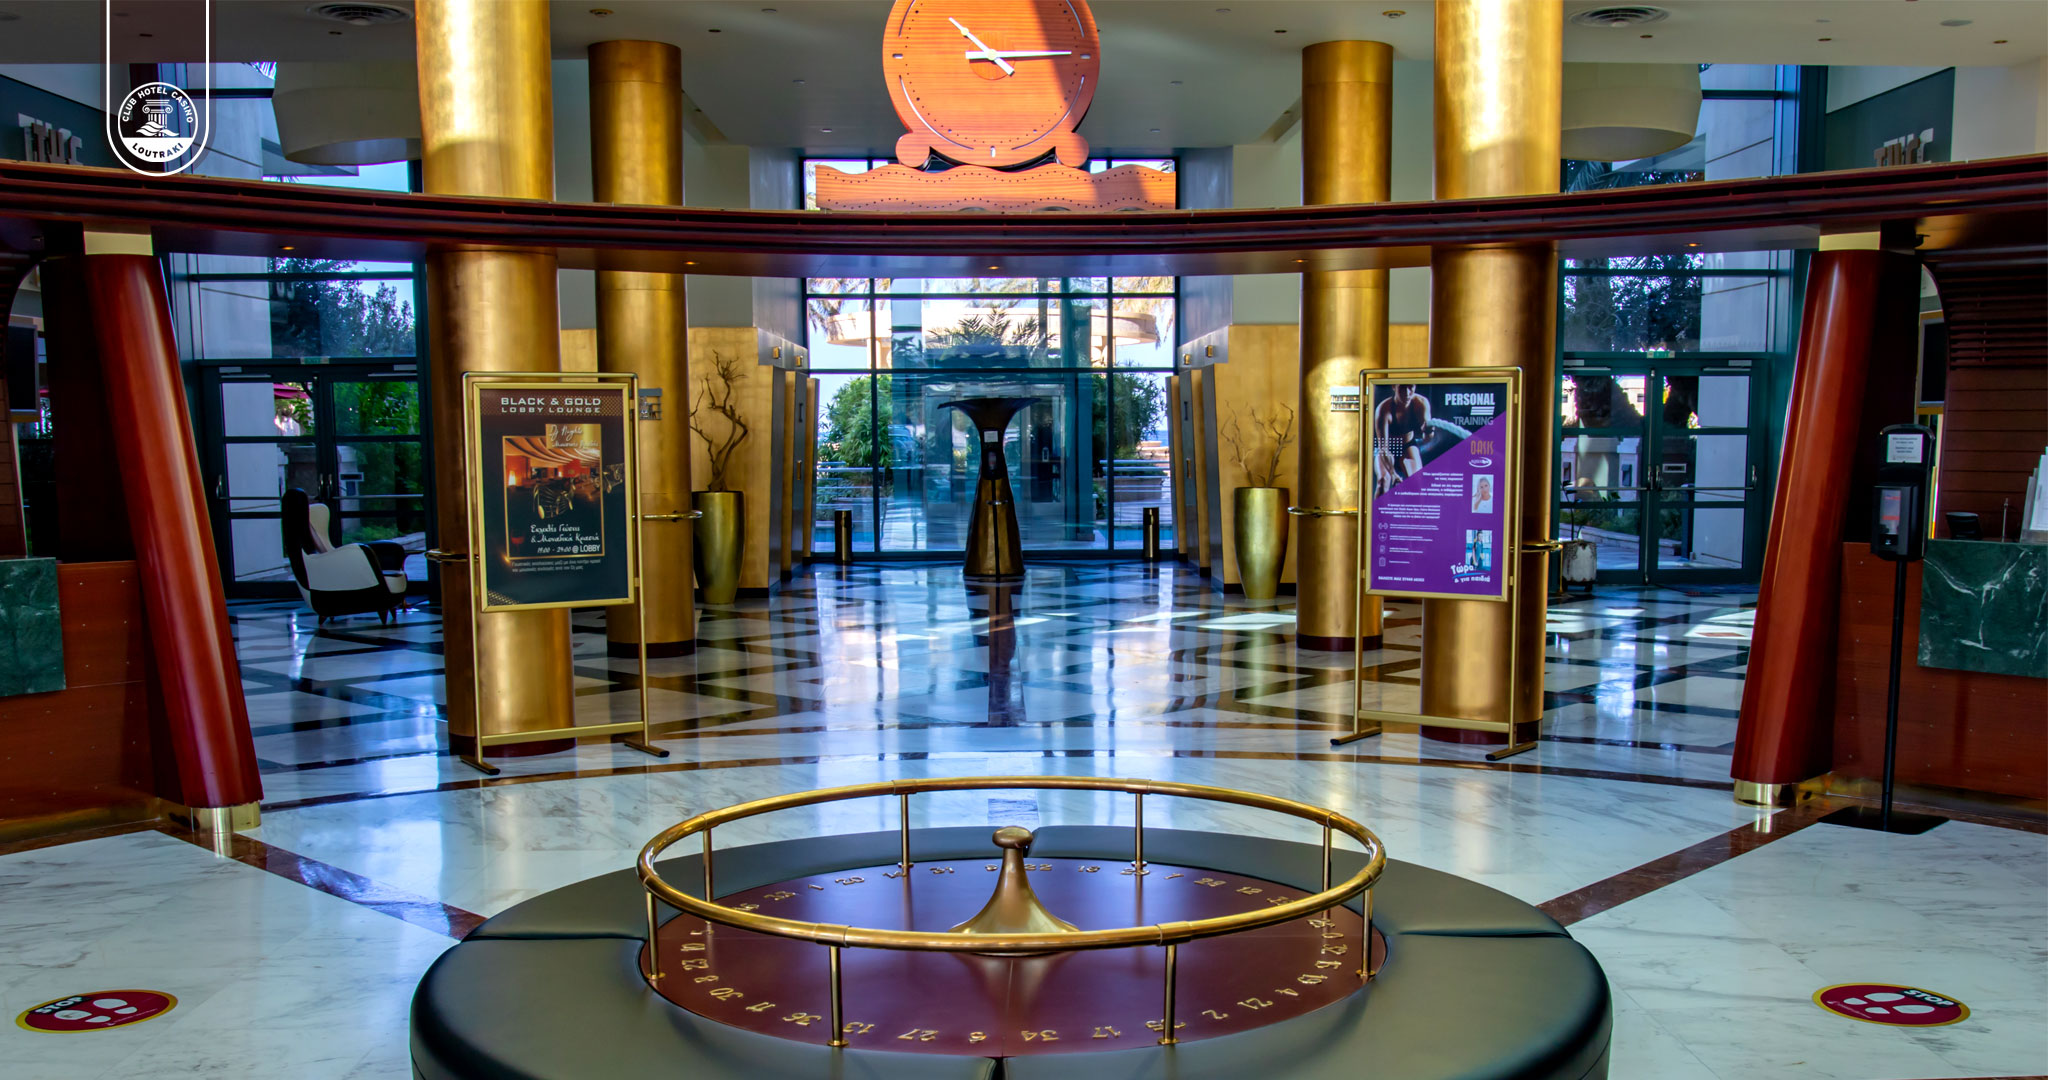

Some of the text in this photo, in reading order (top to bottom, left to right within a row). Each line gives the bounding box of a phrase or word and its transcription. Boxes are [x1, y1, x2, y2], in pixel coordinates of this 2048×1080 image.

[501, 398, 545, 406] BLACK
[1444, 393, 1495, 406] PERSONAL
[1453, 416, 1494, 425] TRAINING
[1471, 440, 1494, 455] OASIS
[1904, 989, 1954, 1006] STOP
[35, 997, 82, 1014] STOP
[897, 1028, 938, 1041] 27
[1020, 1029, 1059, 1041] 34
